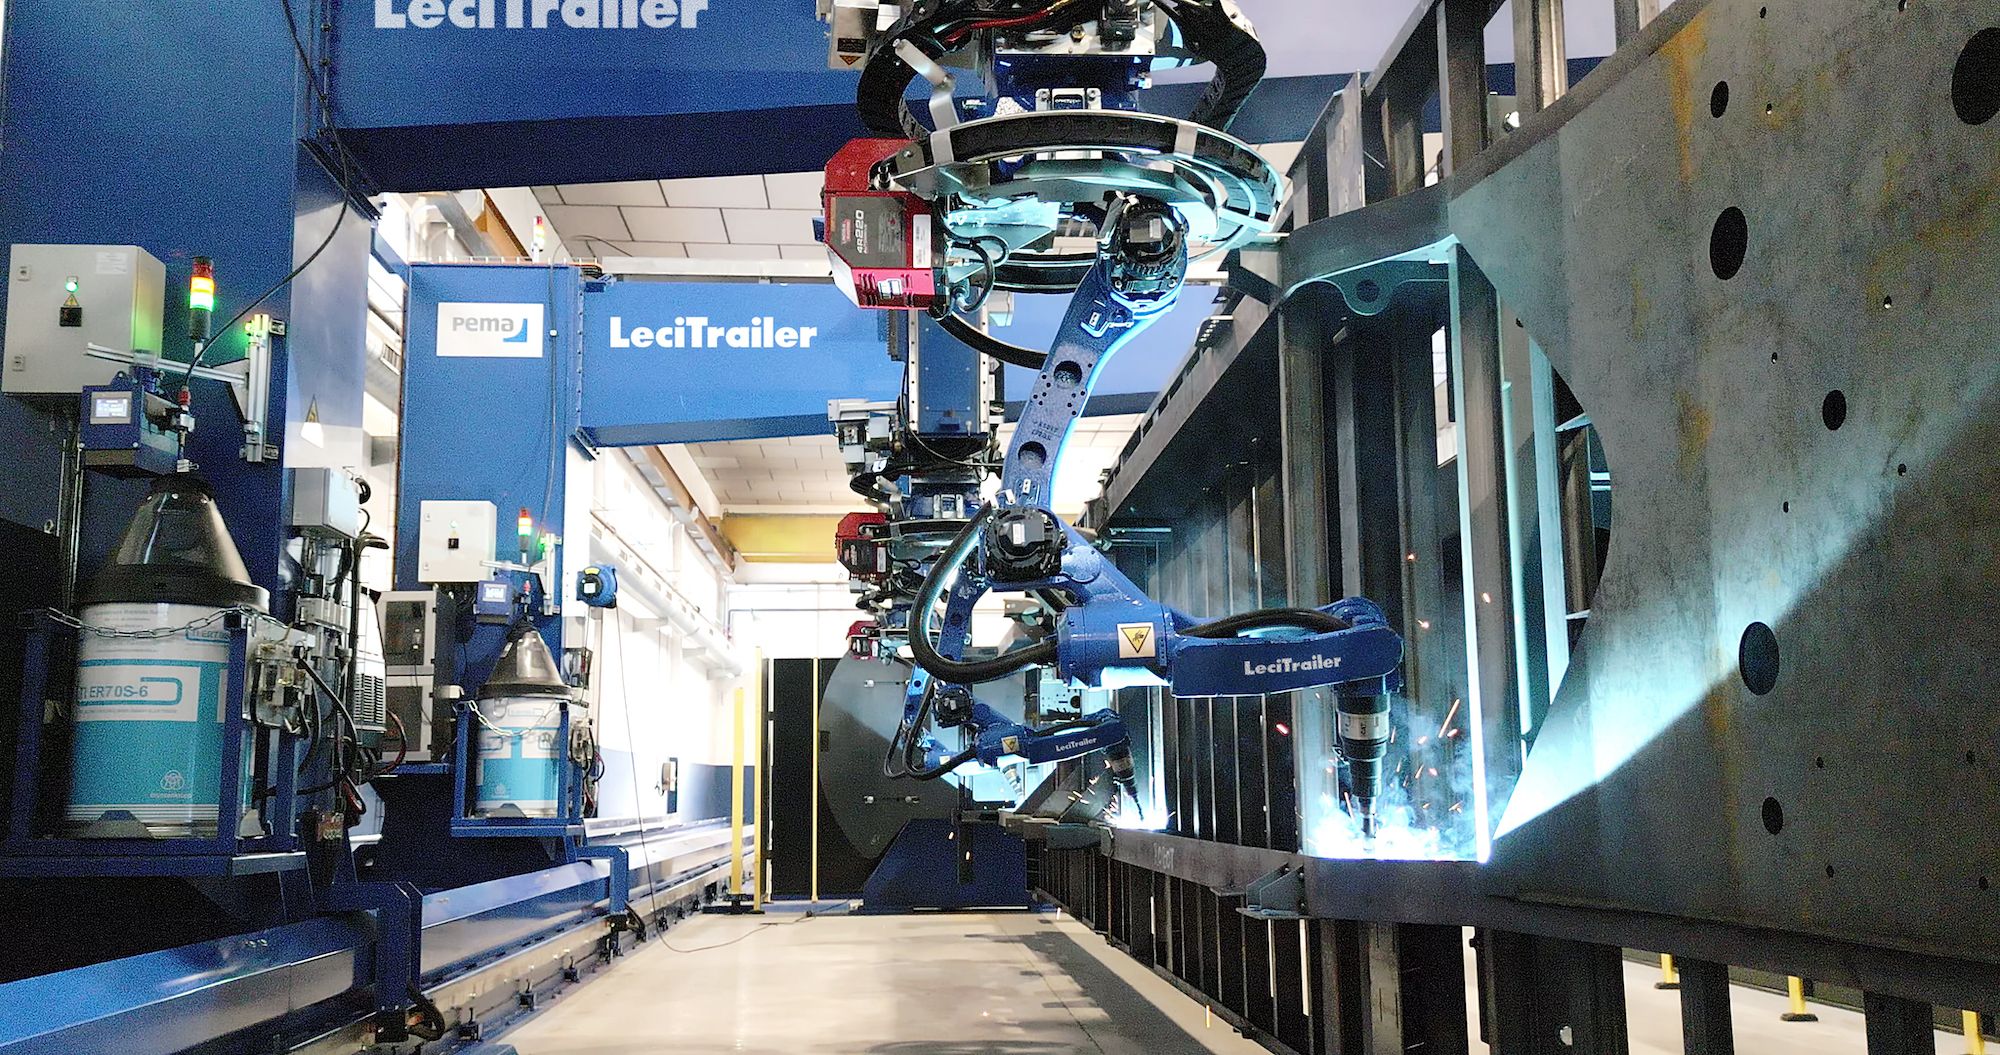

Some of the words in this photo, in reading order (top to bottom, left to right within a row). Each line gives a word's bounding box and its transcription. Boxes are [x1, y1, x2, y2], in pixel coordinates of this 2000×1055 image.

[855, 209, 864, 254] 4R220
[609, 316, 818, 348] LeciTrailer
[1244, 654, 1342, 676] LeciTrailer
[1055, 737, 1097, 752] LeciTrailer
